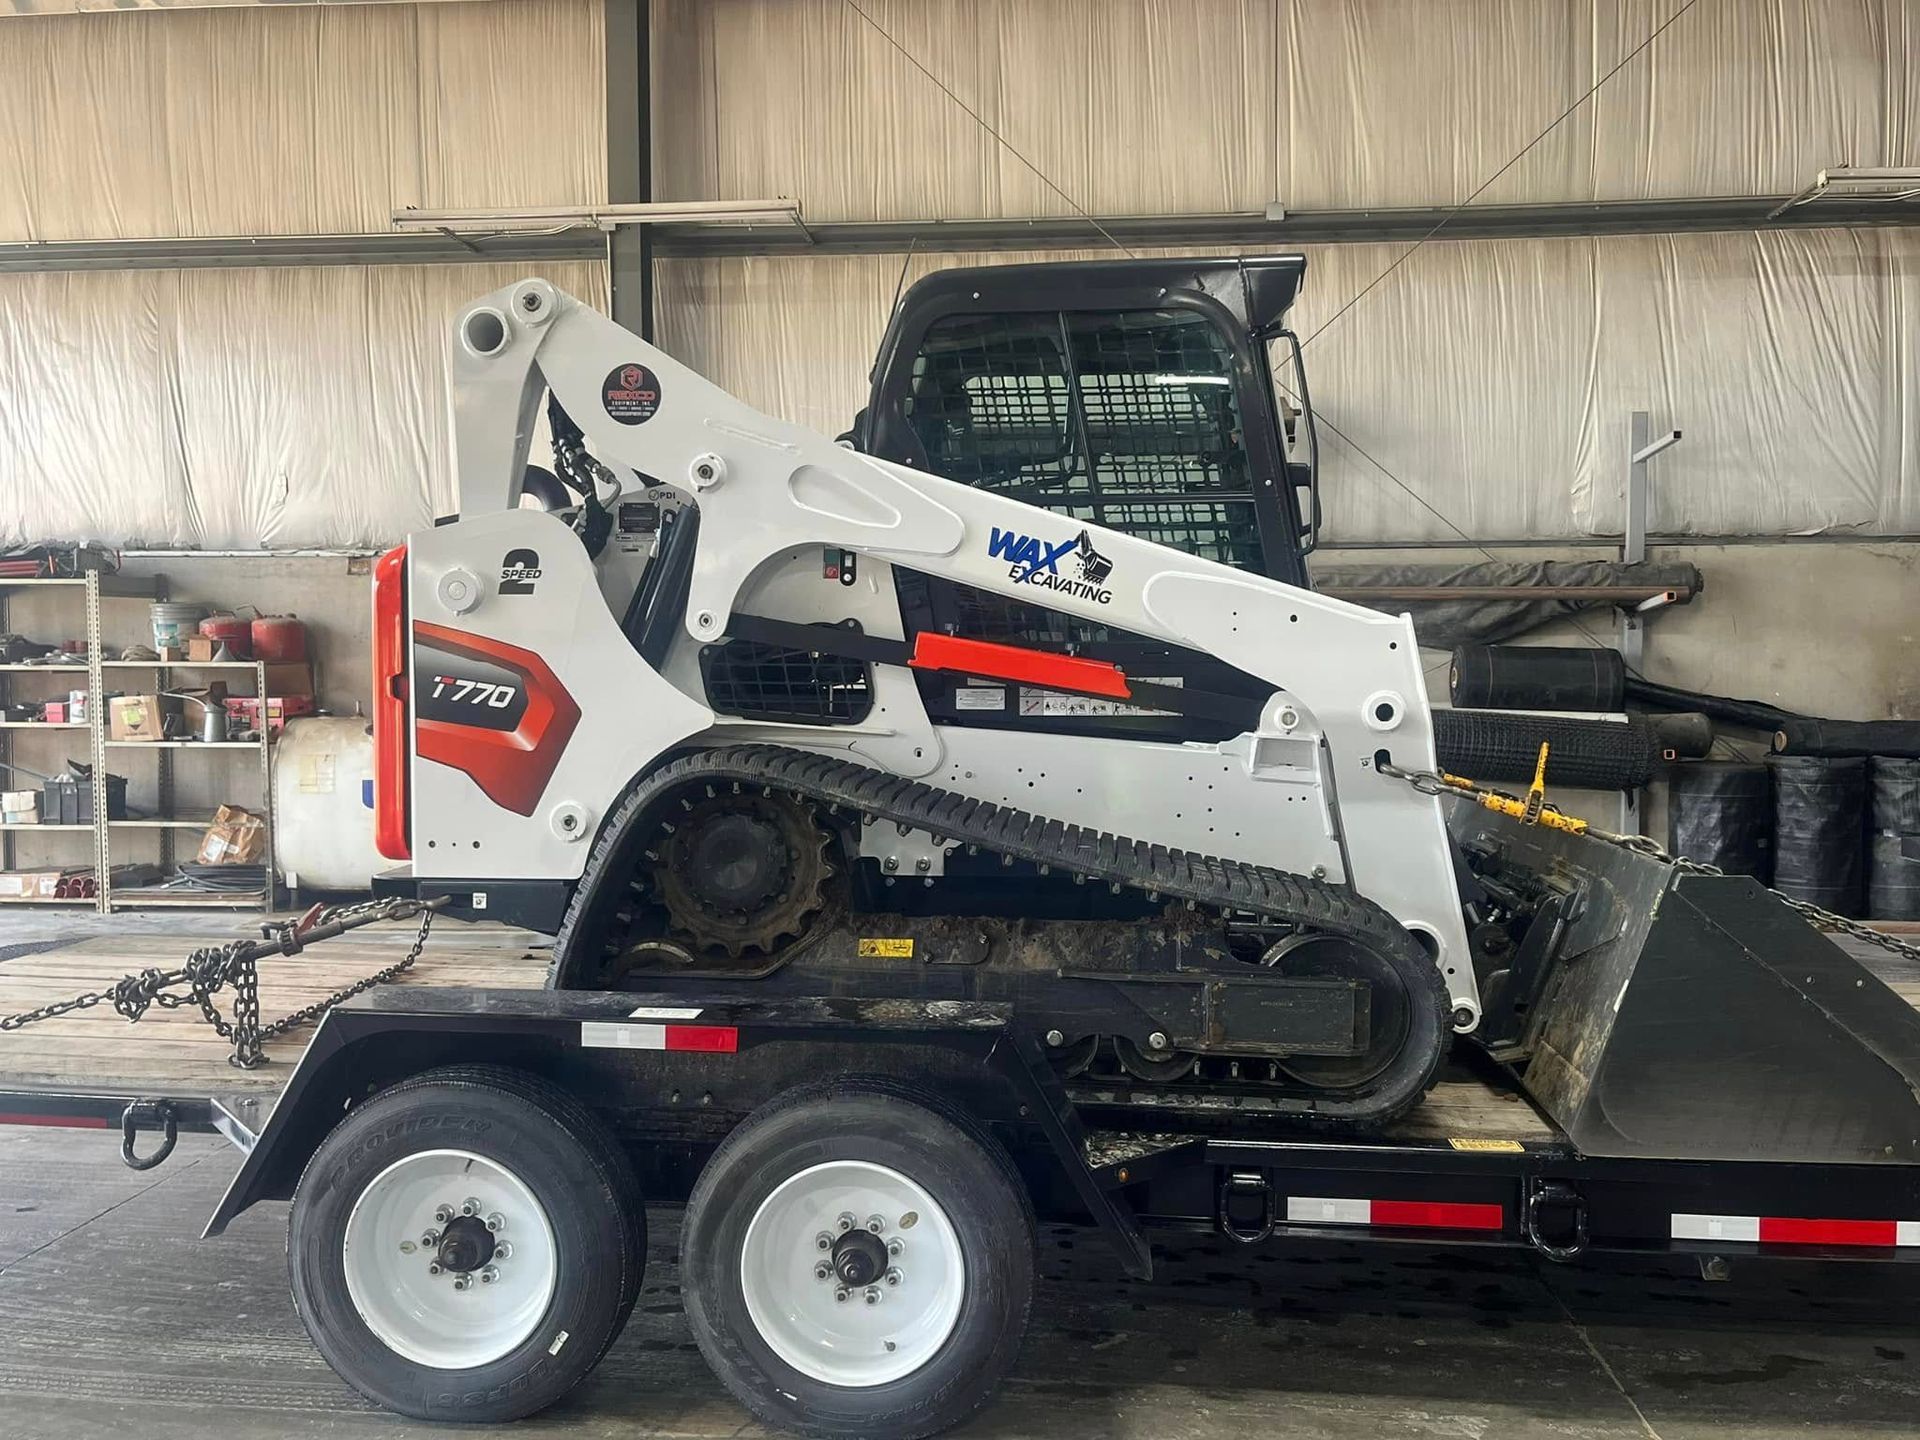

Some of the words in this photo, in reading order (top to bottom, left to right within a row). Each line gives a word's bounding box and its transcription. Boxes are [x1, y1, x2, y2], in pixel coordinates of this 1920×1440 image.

[659, 491, 676, 500] PDI
[498, 548, 540, 595] 2
[988, 527, 1076, 575] WAX
[500, 569, 542, 579] SPEED
[1008, 564, 1113, 605] EXCAVATING
[330, 1113, 493, 1190] PROVIDER
